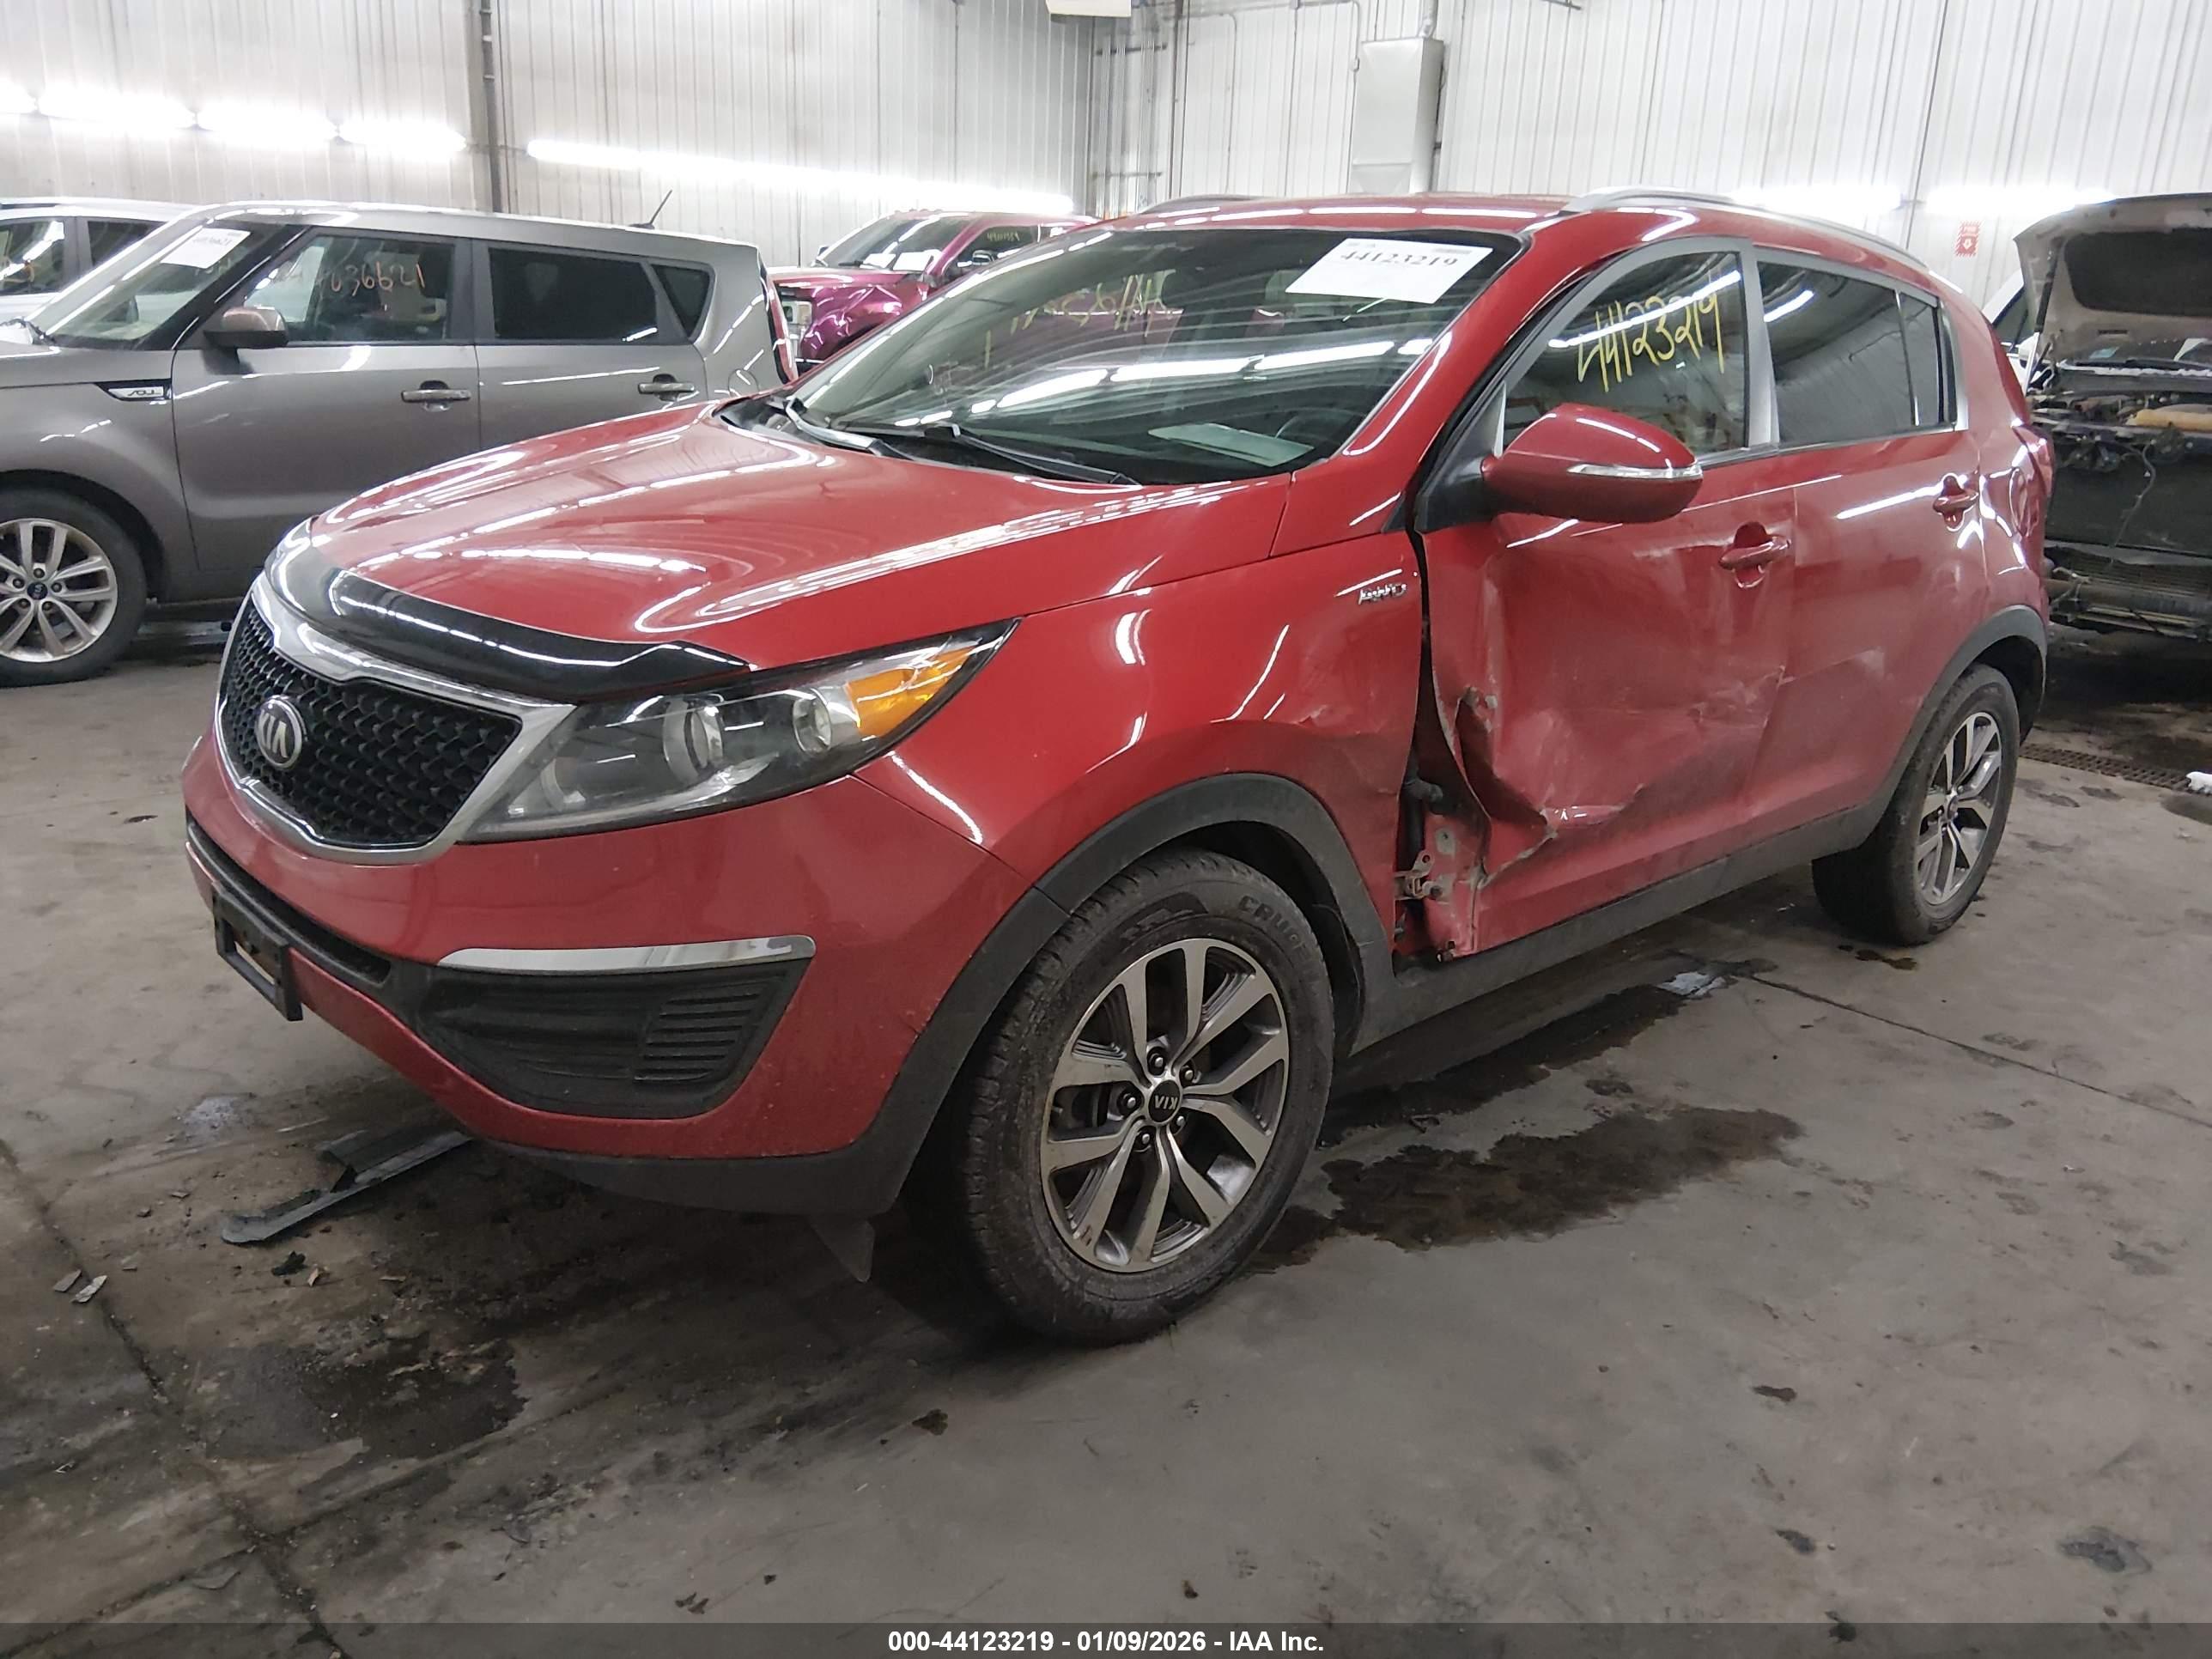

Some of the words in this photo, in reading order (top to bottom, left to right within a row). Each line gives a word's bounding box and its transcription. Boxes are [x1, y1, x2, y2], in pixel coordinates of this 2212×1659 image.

[1577, 295, 1724, 392] 44123219
[258, 708, 289, 758] KIA
[1155, 1095, 1178, 1109] KIA
